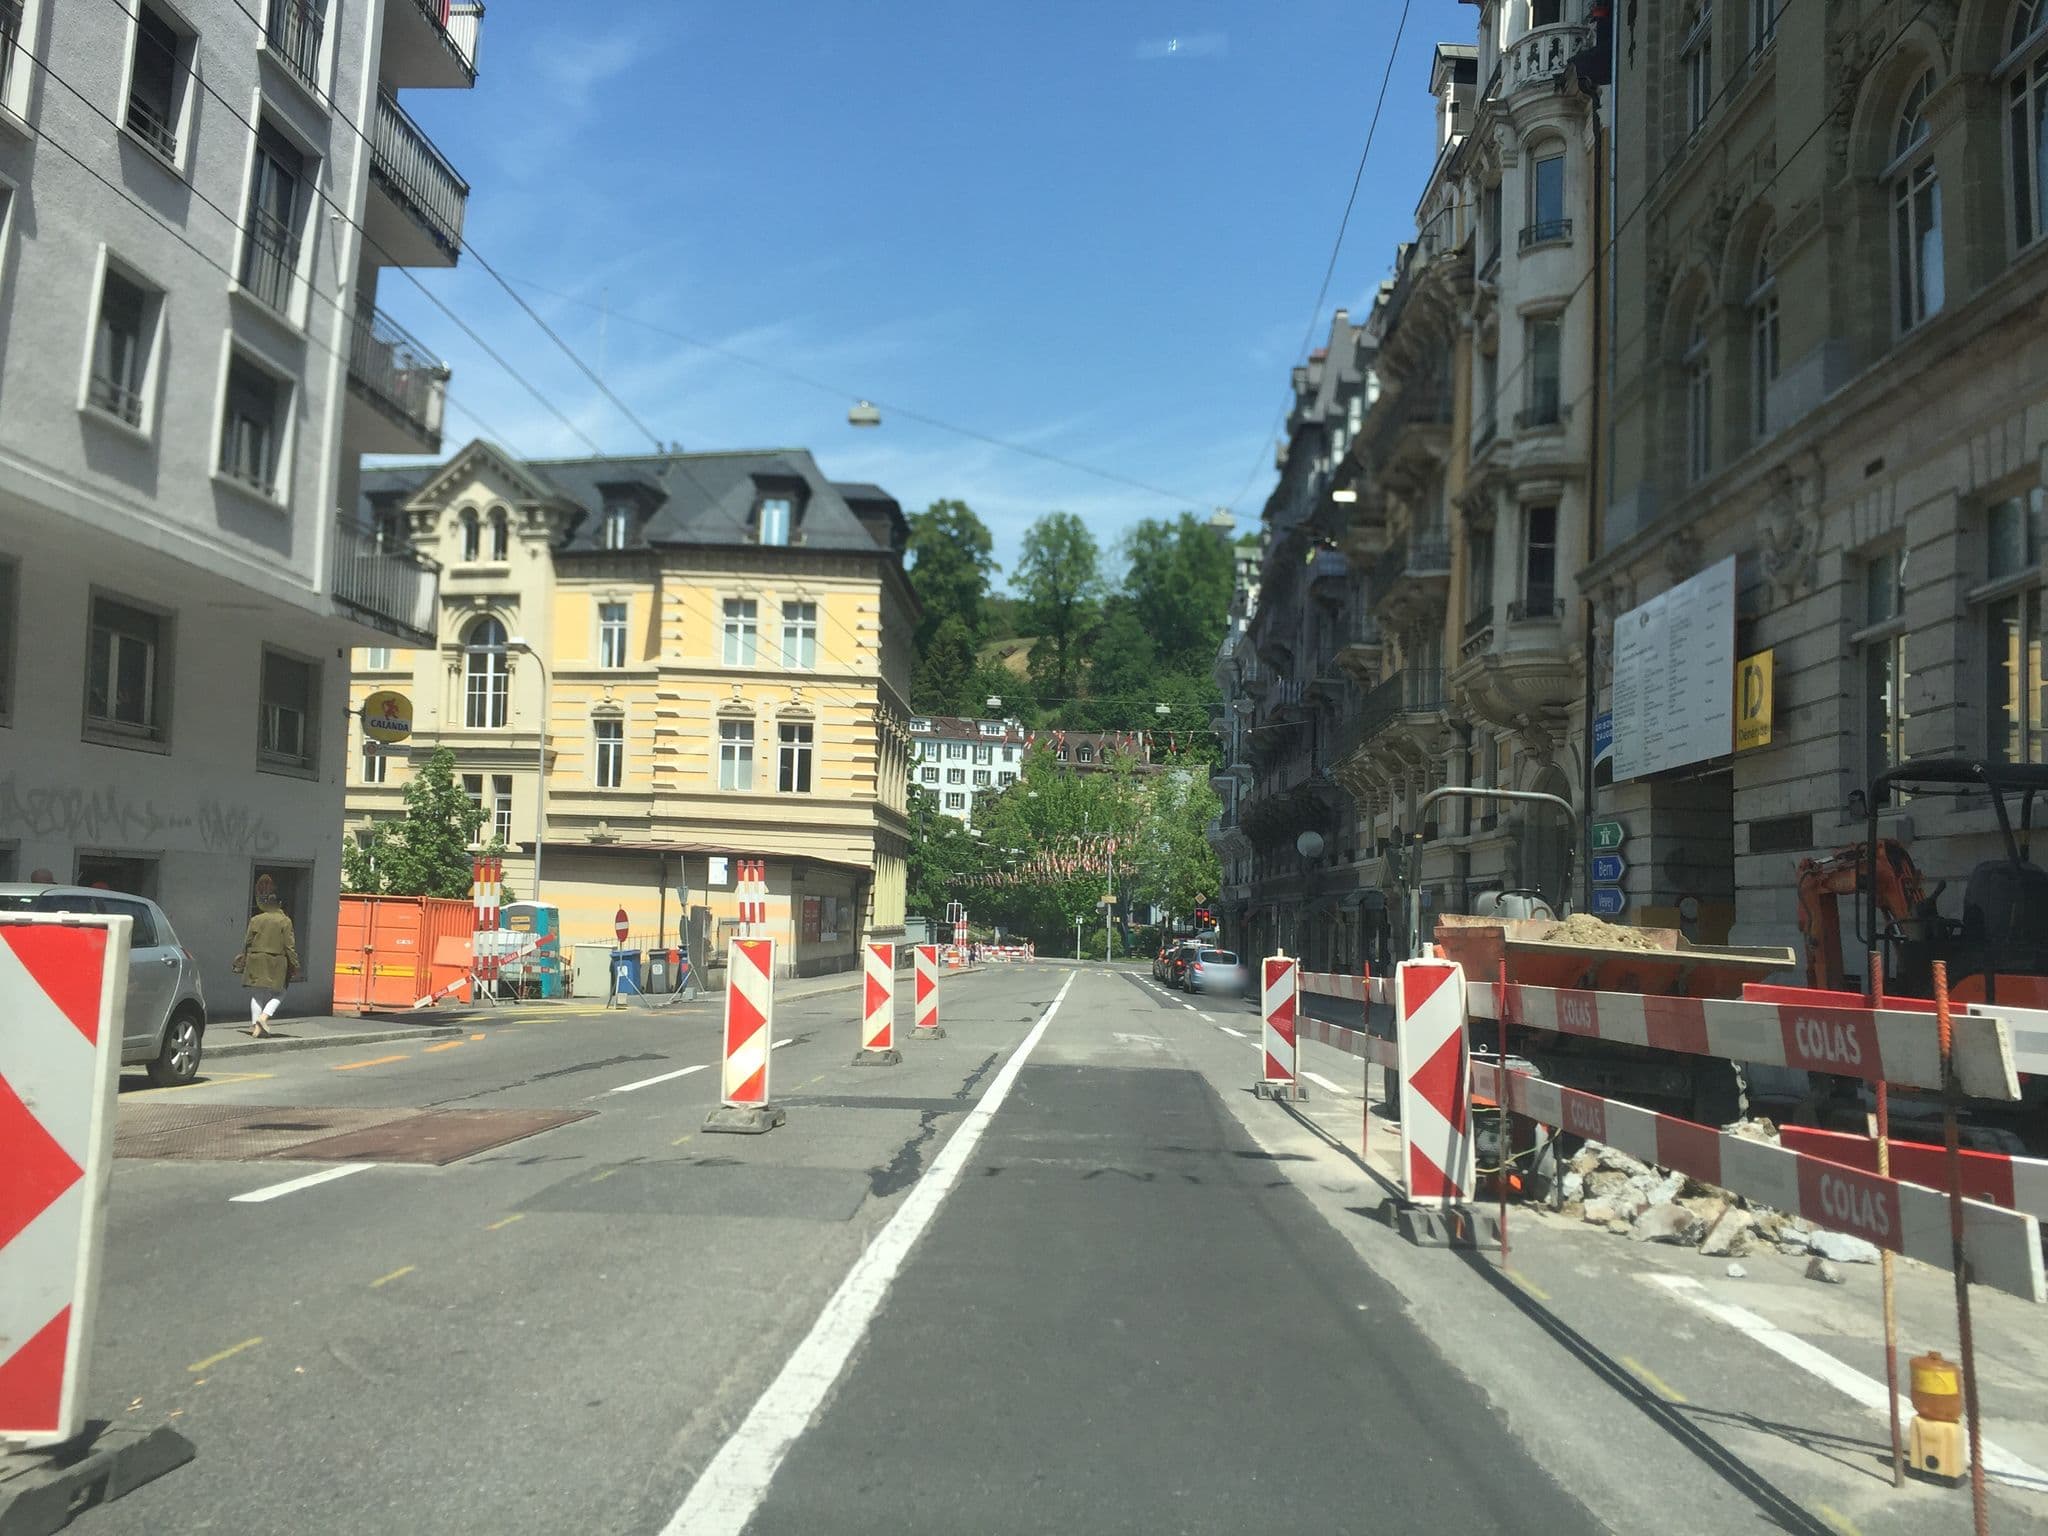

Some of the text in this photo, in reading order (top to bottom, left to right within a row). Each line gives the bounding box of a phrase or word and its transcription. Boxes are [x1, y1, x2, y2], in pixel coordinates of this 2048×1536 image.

[370, 719, 409, 732] CALANDA
[1599, 861, 1614, 876] Bern
[1562, 998, 1591, 1029] COLAS
[1795, 1018, 1861, 1065] COLAS
[1571, 1099, 1602, 1135] COLAS
[1820, 1173, 1889, 1237] COLAS
